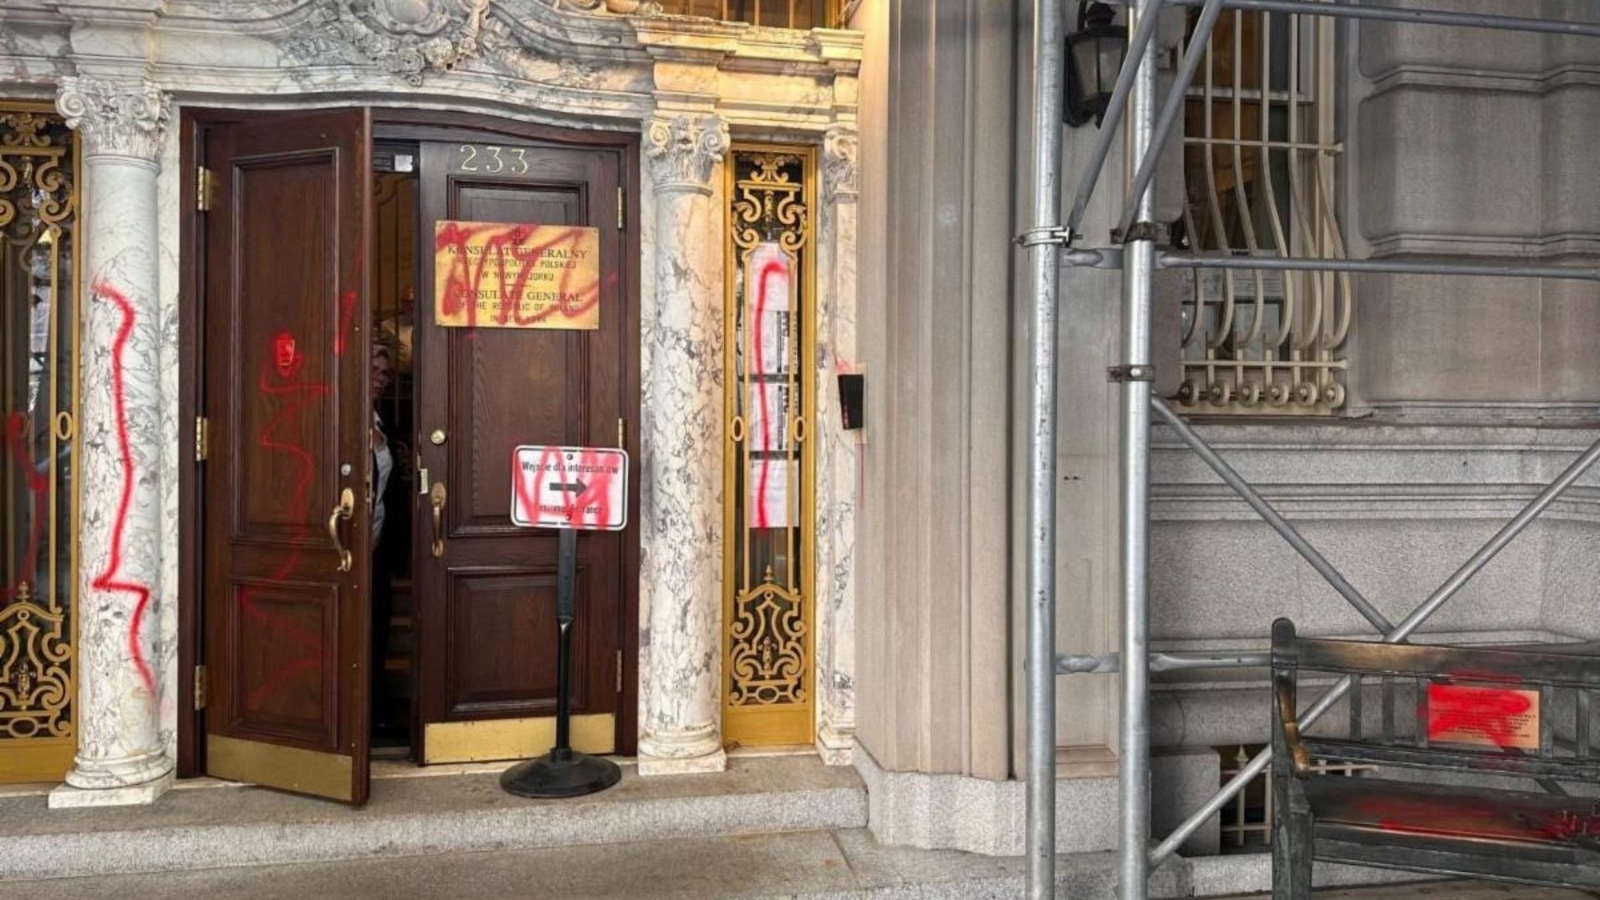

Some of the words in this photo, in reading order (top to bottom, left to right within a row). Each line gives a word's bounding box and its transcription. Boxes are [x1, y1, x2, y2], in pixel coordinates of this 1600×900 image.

[460, 145, 528, 173] 233
[447, 244, 509, 256] KNSULT
[513, 247, 587, 259] GEERALNY
[493, 271, 526, 280] NWY
[453, 288, 522, 300] NSULAE
[526, 291, 583, 302] GENERAL
[492, 302, 531, 311] REIC
[522, 461, 552, 473] Wejie
[567, 463, 619, 475] interesanw
